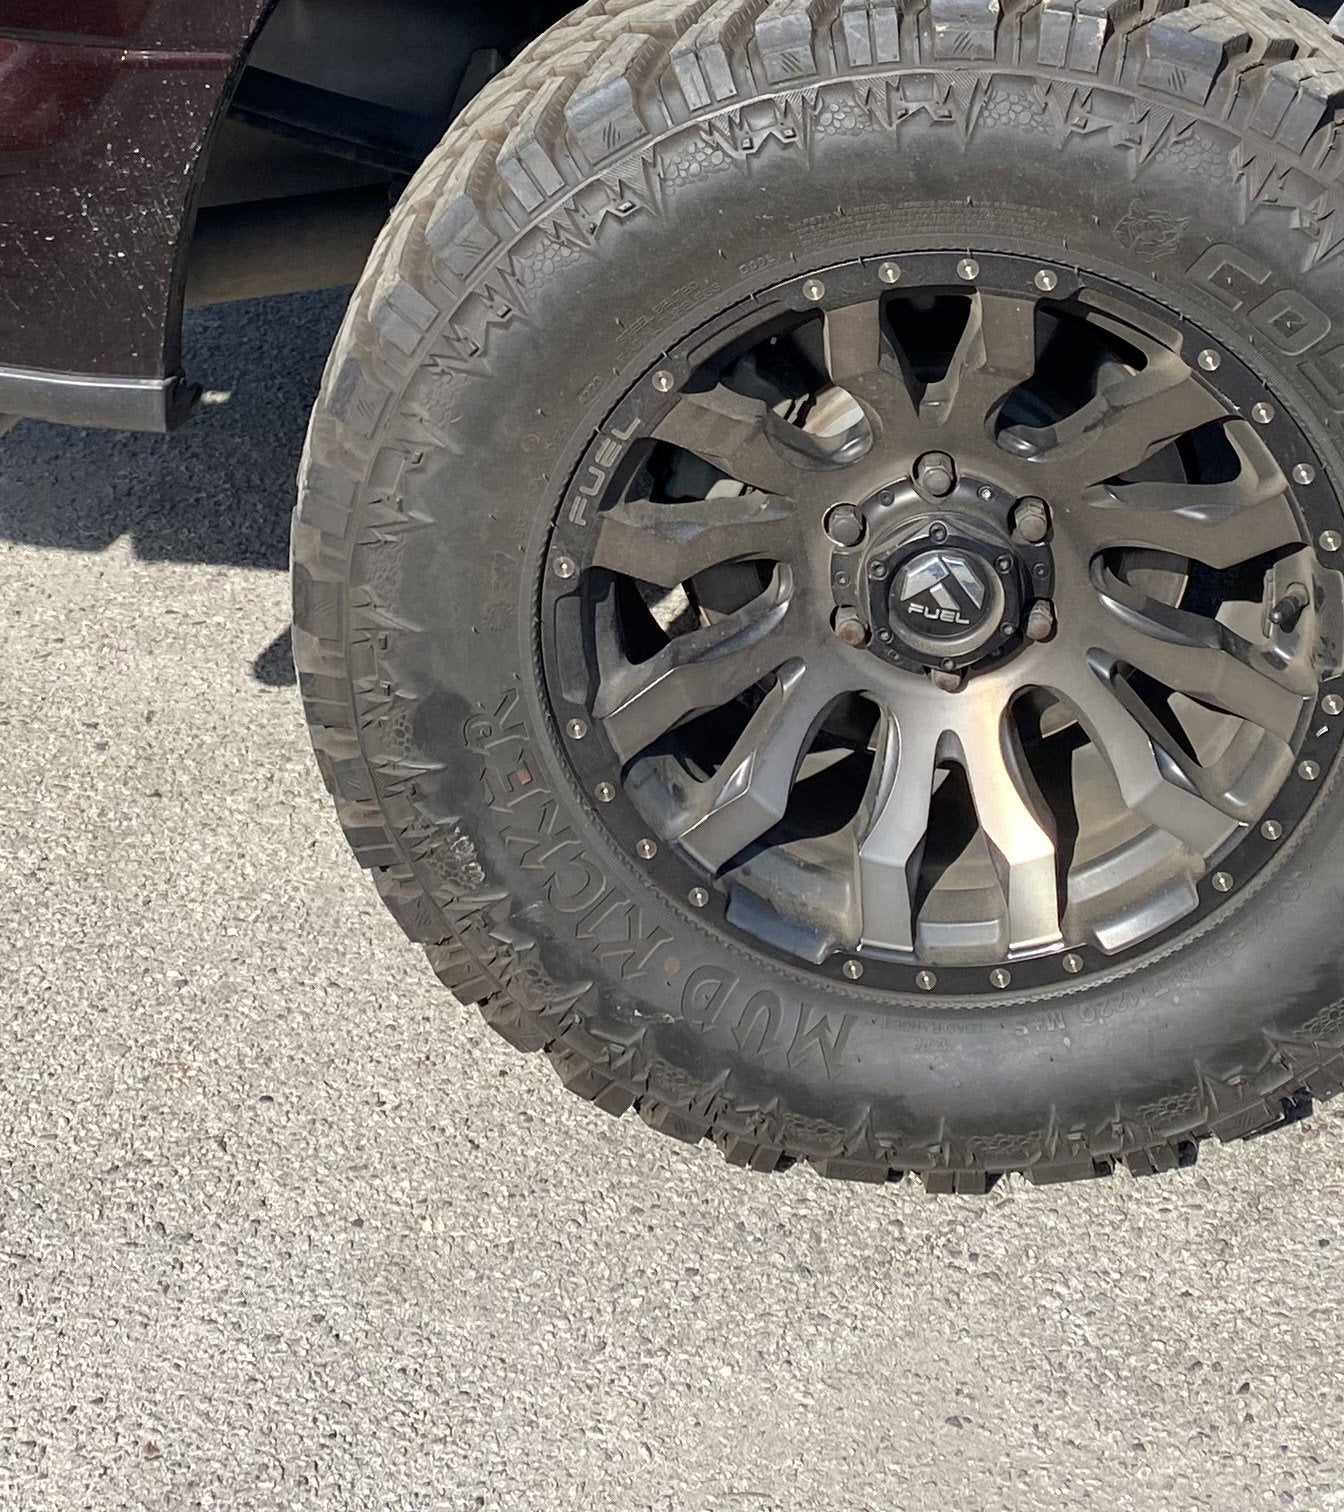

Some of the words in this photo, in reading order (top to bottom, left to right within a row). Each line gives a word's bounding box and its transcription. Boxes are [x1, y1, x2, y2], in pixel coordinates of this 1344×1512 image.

[568, 417, 642, 527] FUEL
[907, 603, 970, 625] FUEL
[462, 686, 675, 980] KICKER
[679, 964, 852, 1081] MUD
